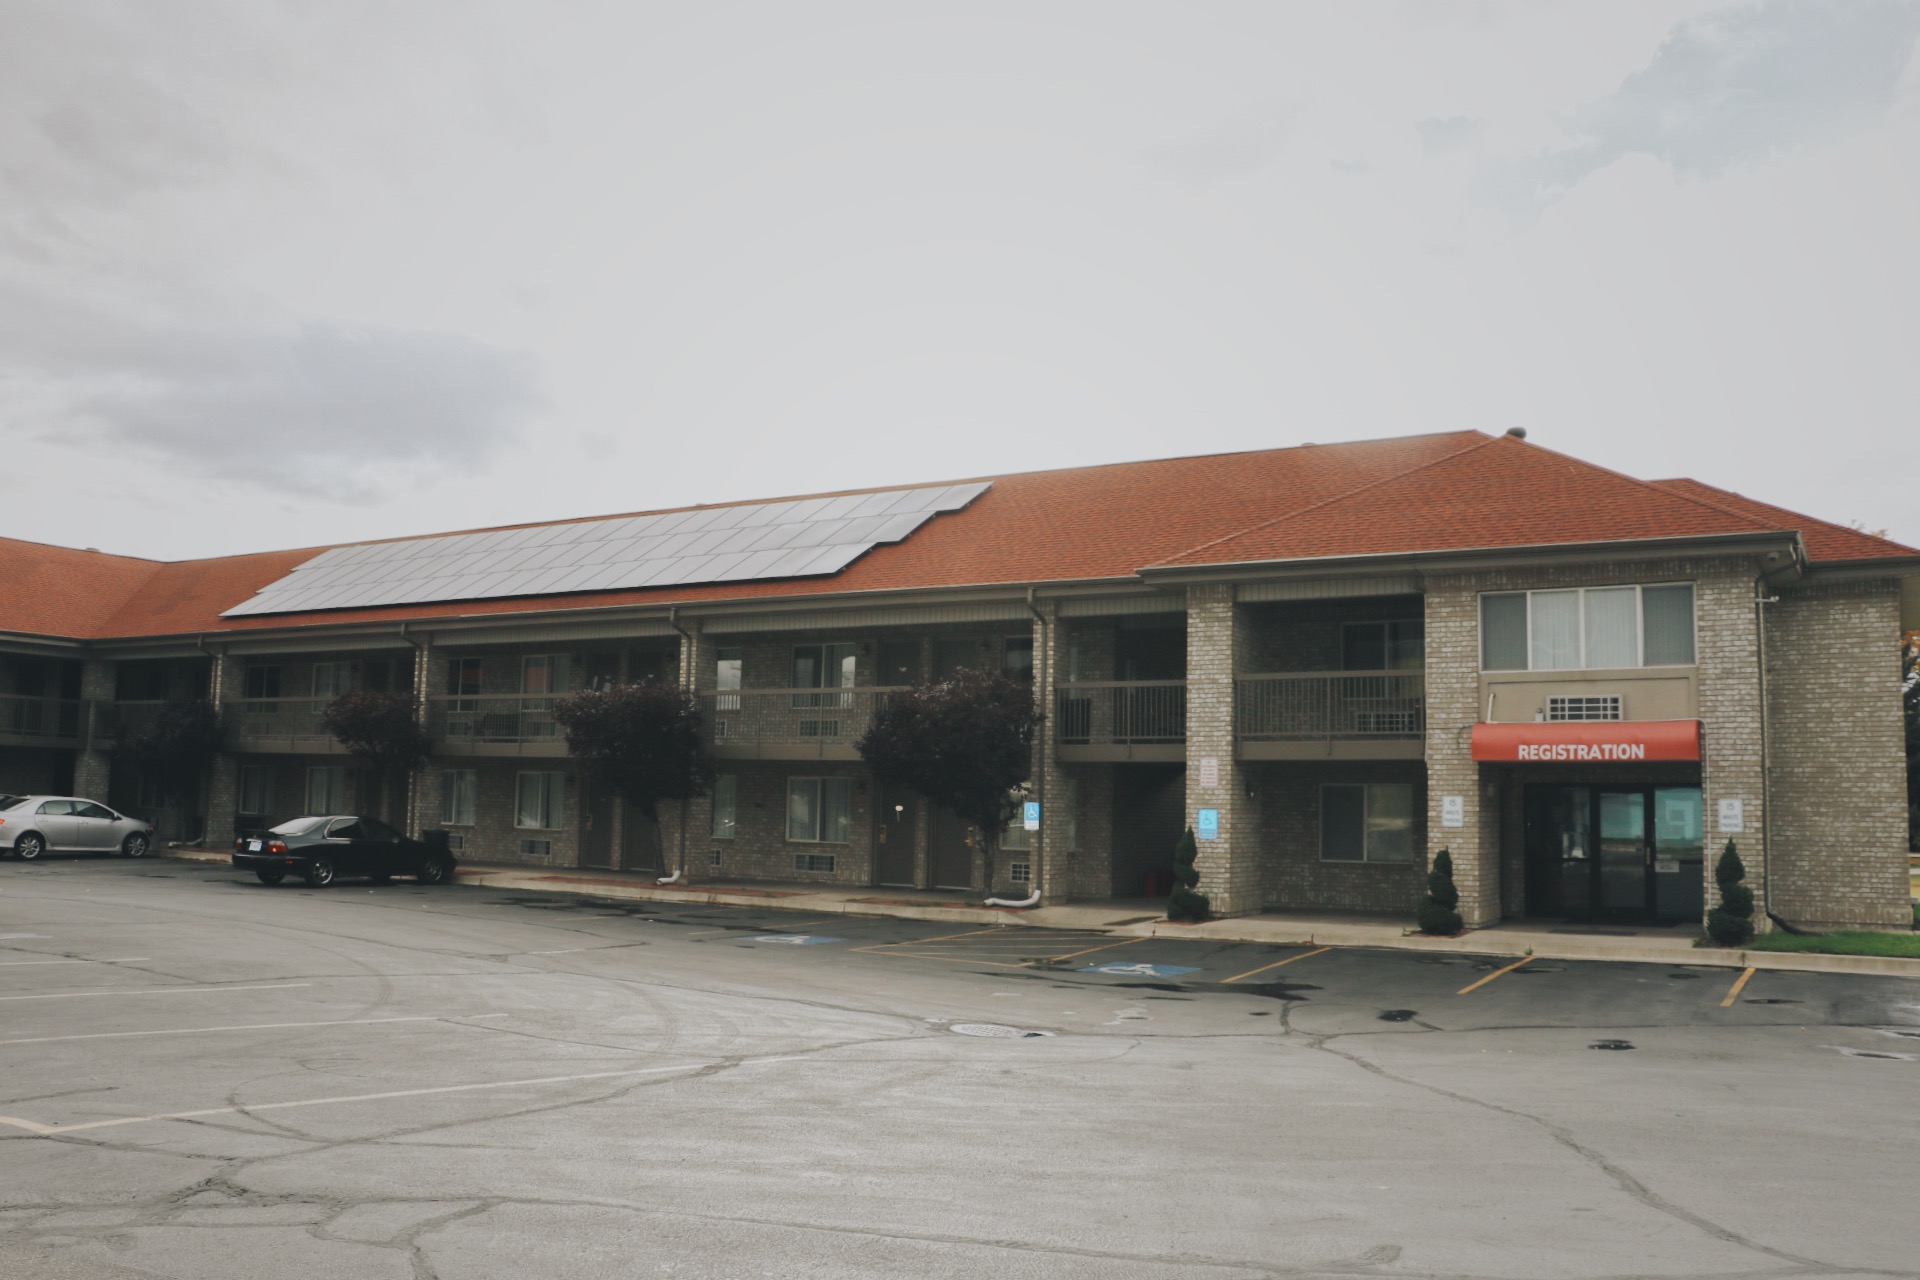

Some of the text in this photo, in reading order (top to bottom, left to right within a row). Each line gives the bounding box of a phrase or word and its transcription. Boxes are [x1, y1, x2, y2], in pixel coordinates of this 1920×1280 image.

[1518, 744, 1645, 760] REGISTRATION
[1449, 799, 1457, 807] 15
[1726, 802, 1735, 810] 15
